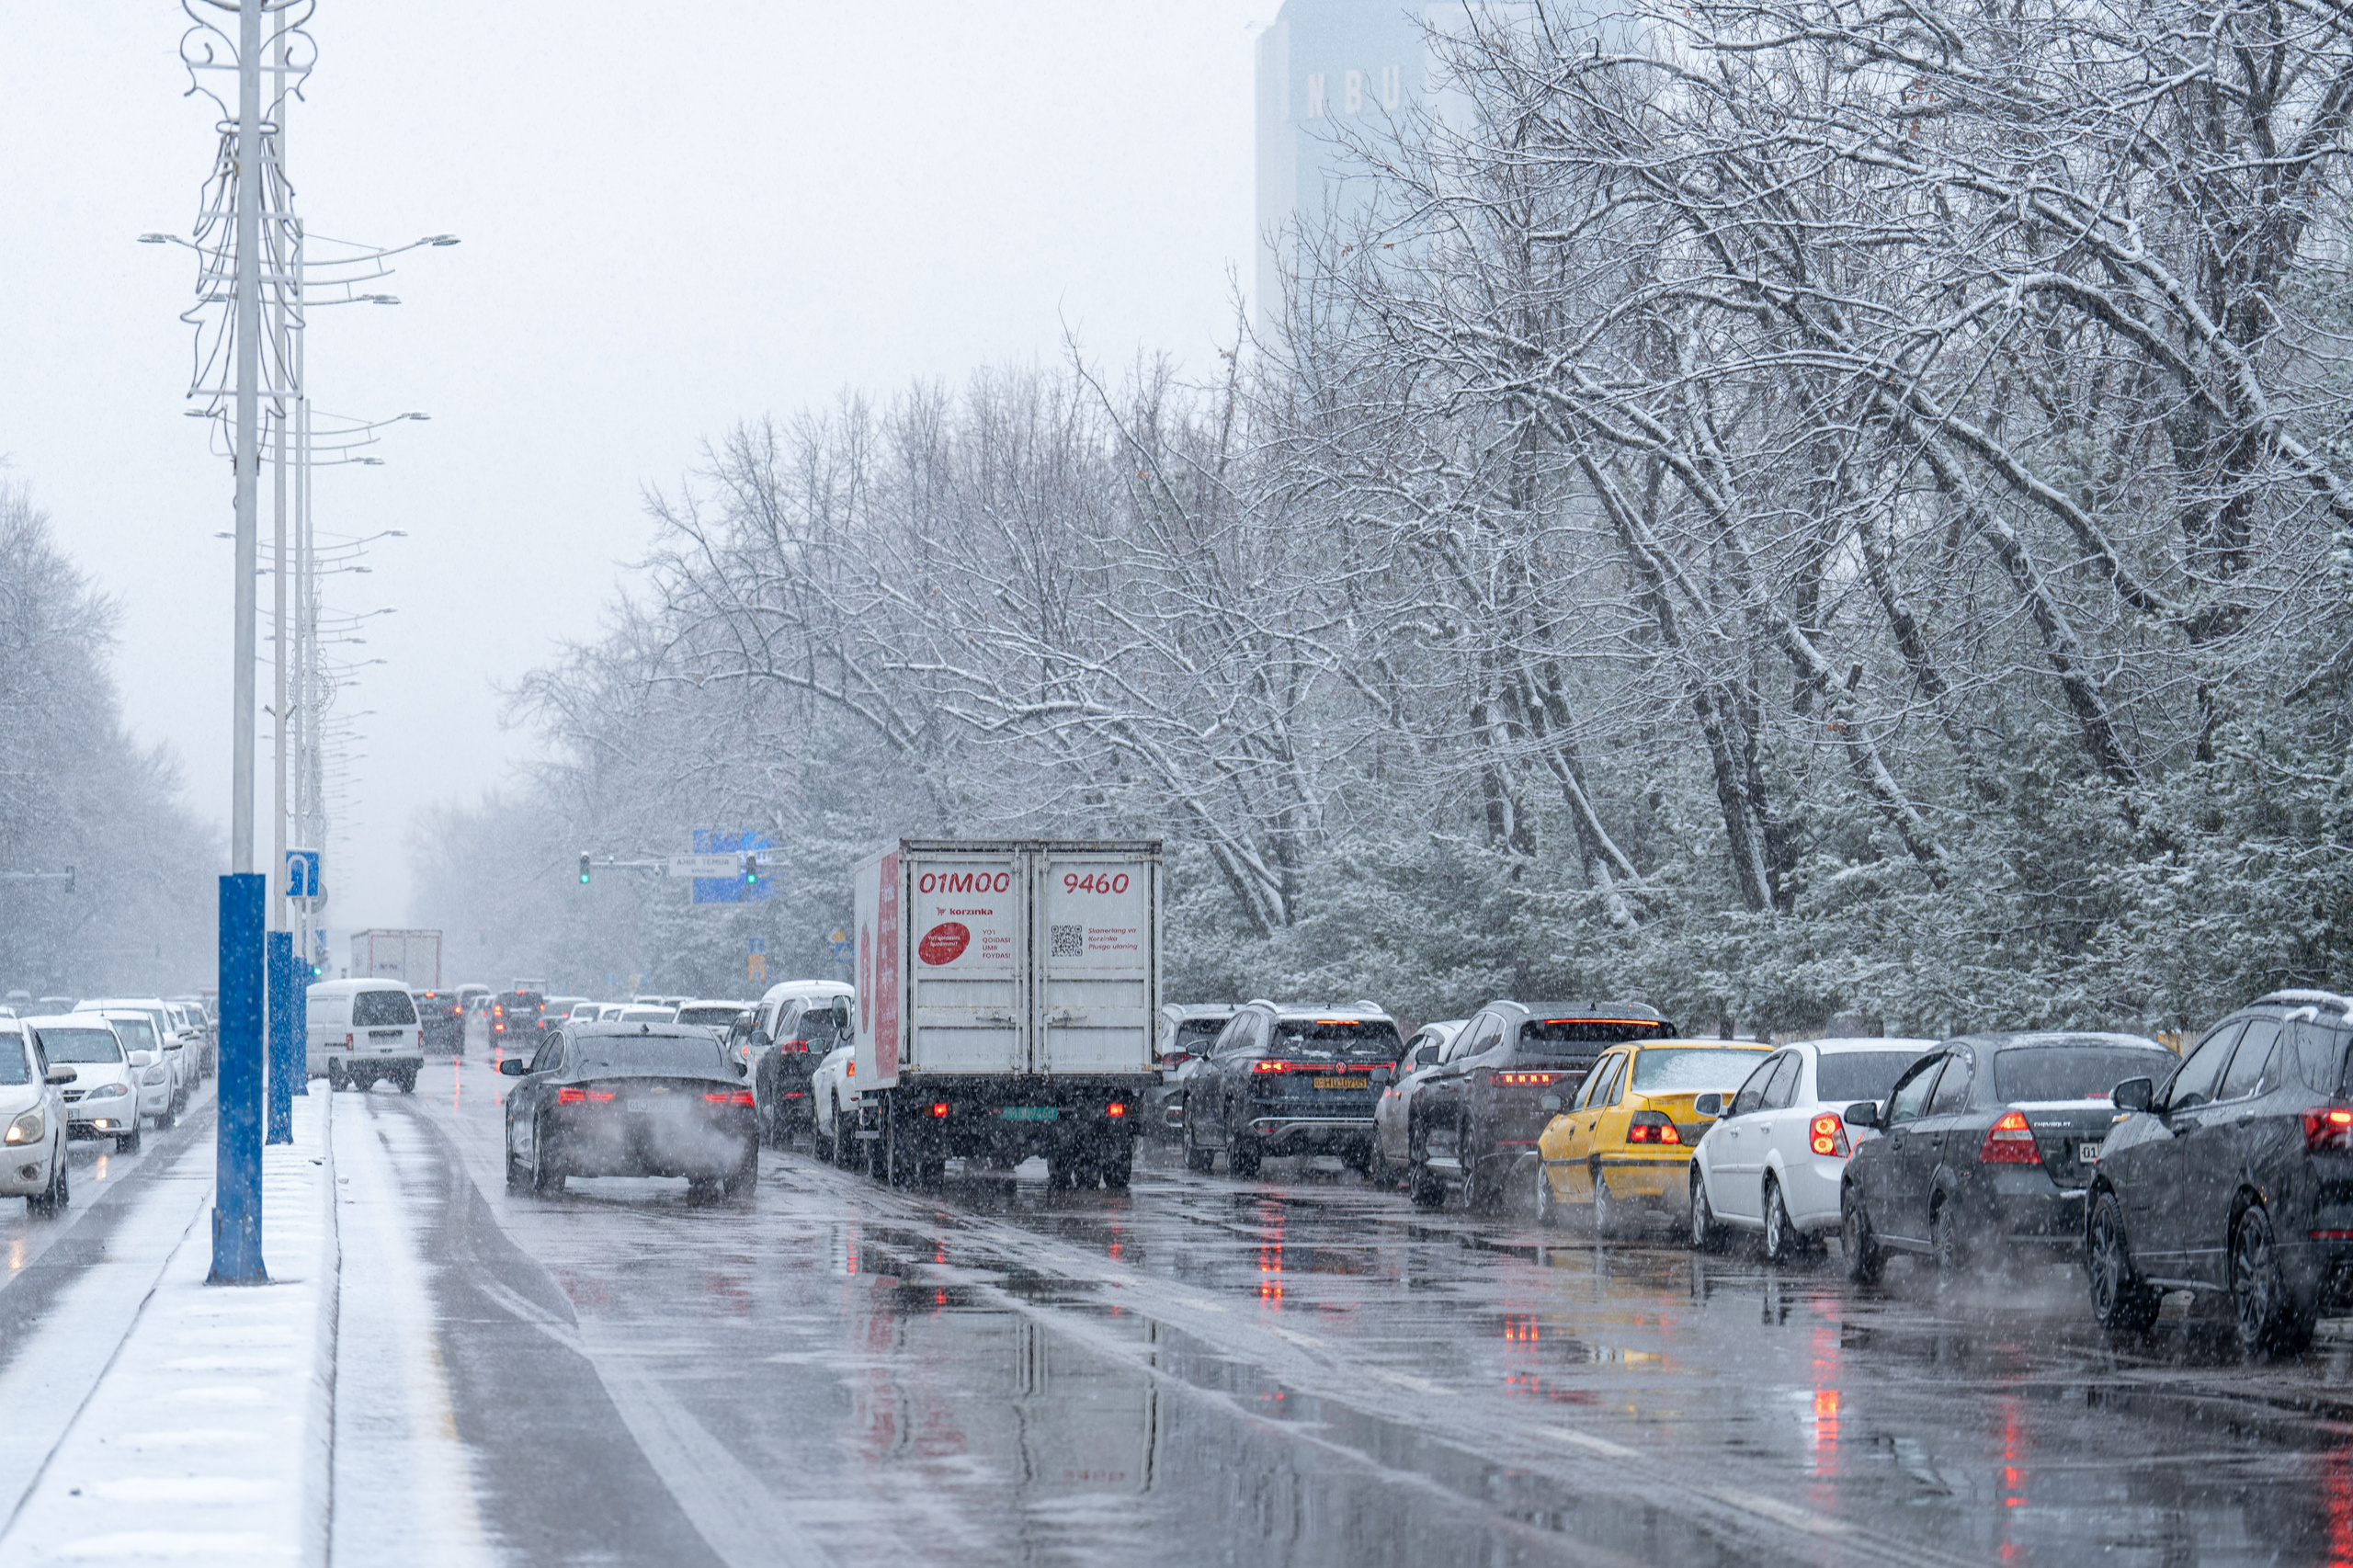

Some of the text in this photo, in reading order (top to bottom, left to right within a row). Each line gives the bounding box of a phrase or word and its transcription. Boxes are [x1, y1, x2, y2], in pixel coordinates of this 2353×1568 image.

[1307, 65, 1401, 118] NBU
[919, 871, 1010, 893] 01M00
[1063, 872, 1130, 894] 9460
[949, 907, 994, 915] korzinka
